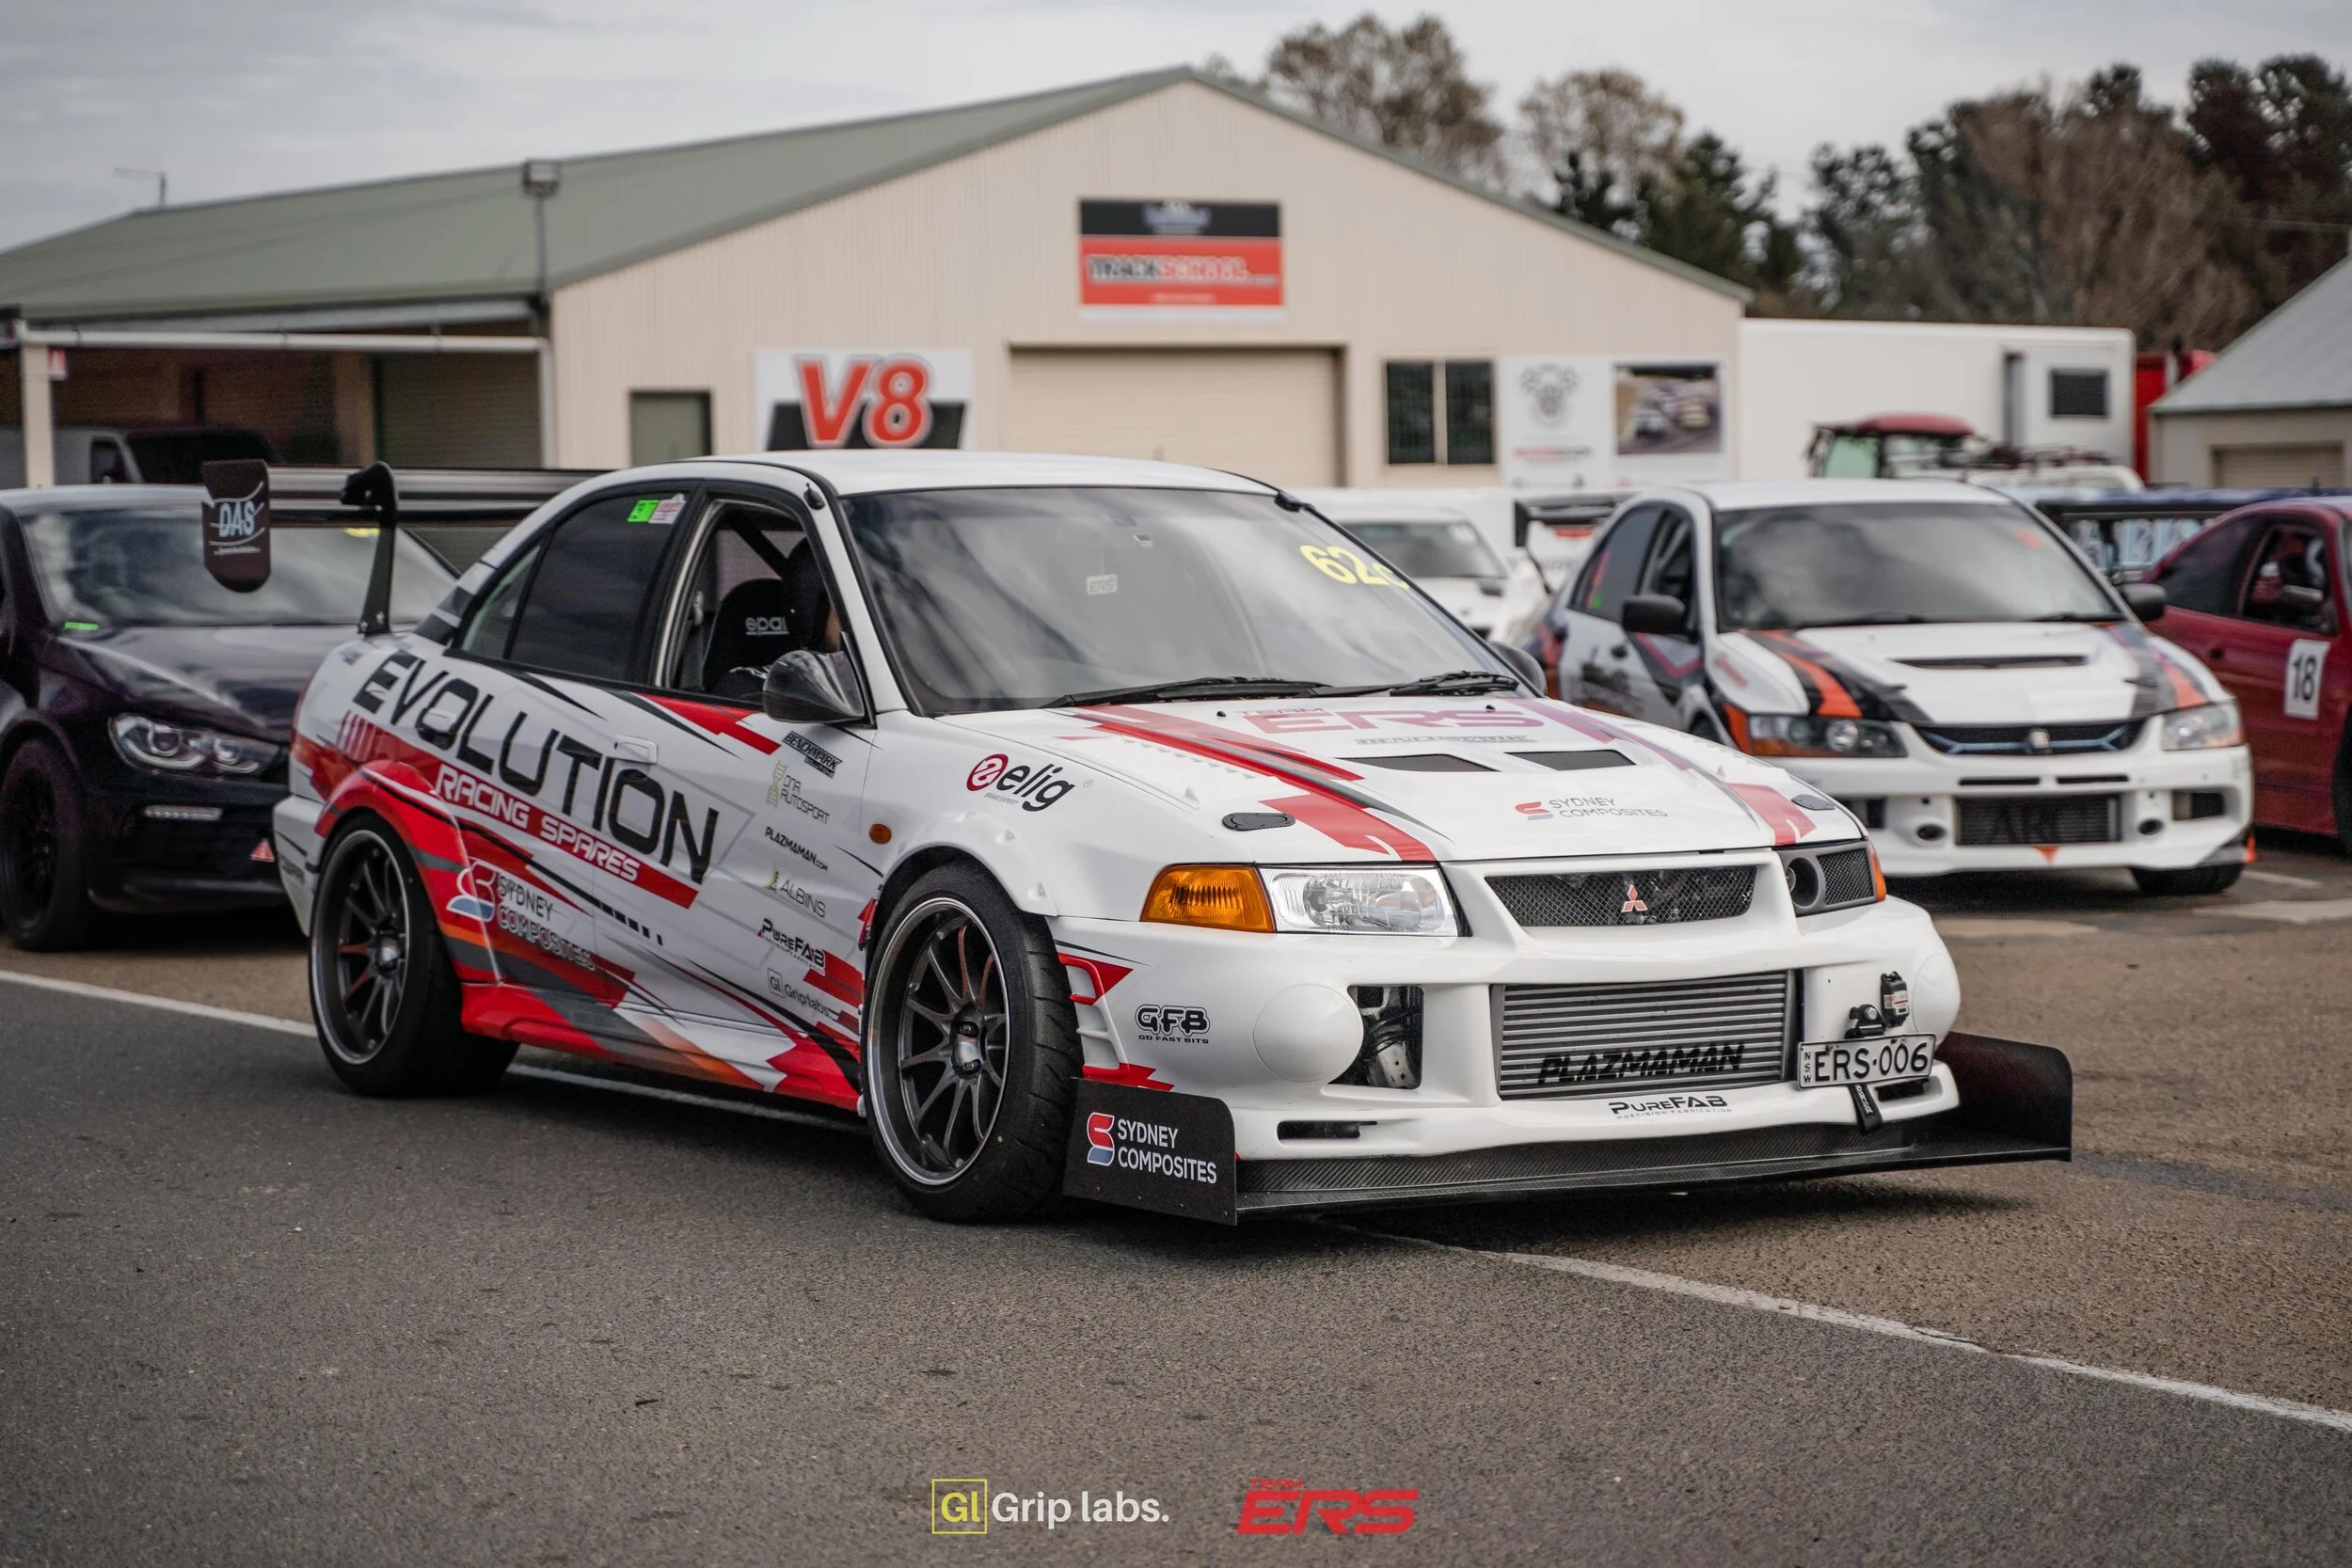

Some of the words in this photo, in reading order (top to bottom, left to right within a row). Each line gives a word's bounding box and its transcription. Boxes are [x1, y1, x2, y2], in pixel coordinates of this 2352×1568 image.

[797, 356, 933, 448] V8
[218, 500, 255, 537] DAS
[2293, 653, 2317, 701] 18
[1242, 710, 1545, 734] ERS
[353, 649, 720, 885] EVOLUTION
[783, 731, 843, 770] BENCHMARK
[435, 764, 531, 829] RACING
[779, 788, 830, 825] AUTOSPORT
[996, 764, 1076, 812] elig
[1549, 798, 1615, 809] SYDNEY
[1559, 808, 1668, 817] COMPOSITES
[540, 814, 642, 882] SPARES
[498, 875, 553, 922] SYDNEY
[779, 879, 826, 918] ALBINS
[497, 906, 596, 972] COMPOSITES
[1136, 1005, 1210, 1036] GFB
[1538, 1042, 1744, 1085] PLAZMAMAN
[1118, 1119, 1178, 1148] SYDNEY
[1617, 1110, 1667, 1120] PRECISION
[1118, 1147, 1217, 1184] COMPOSITES
